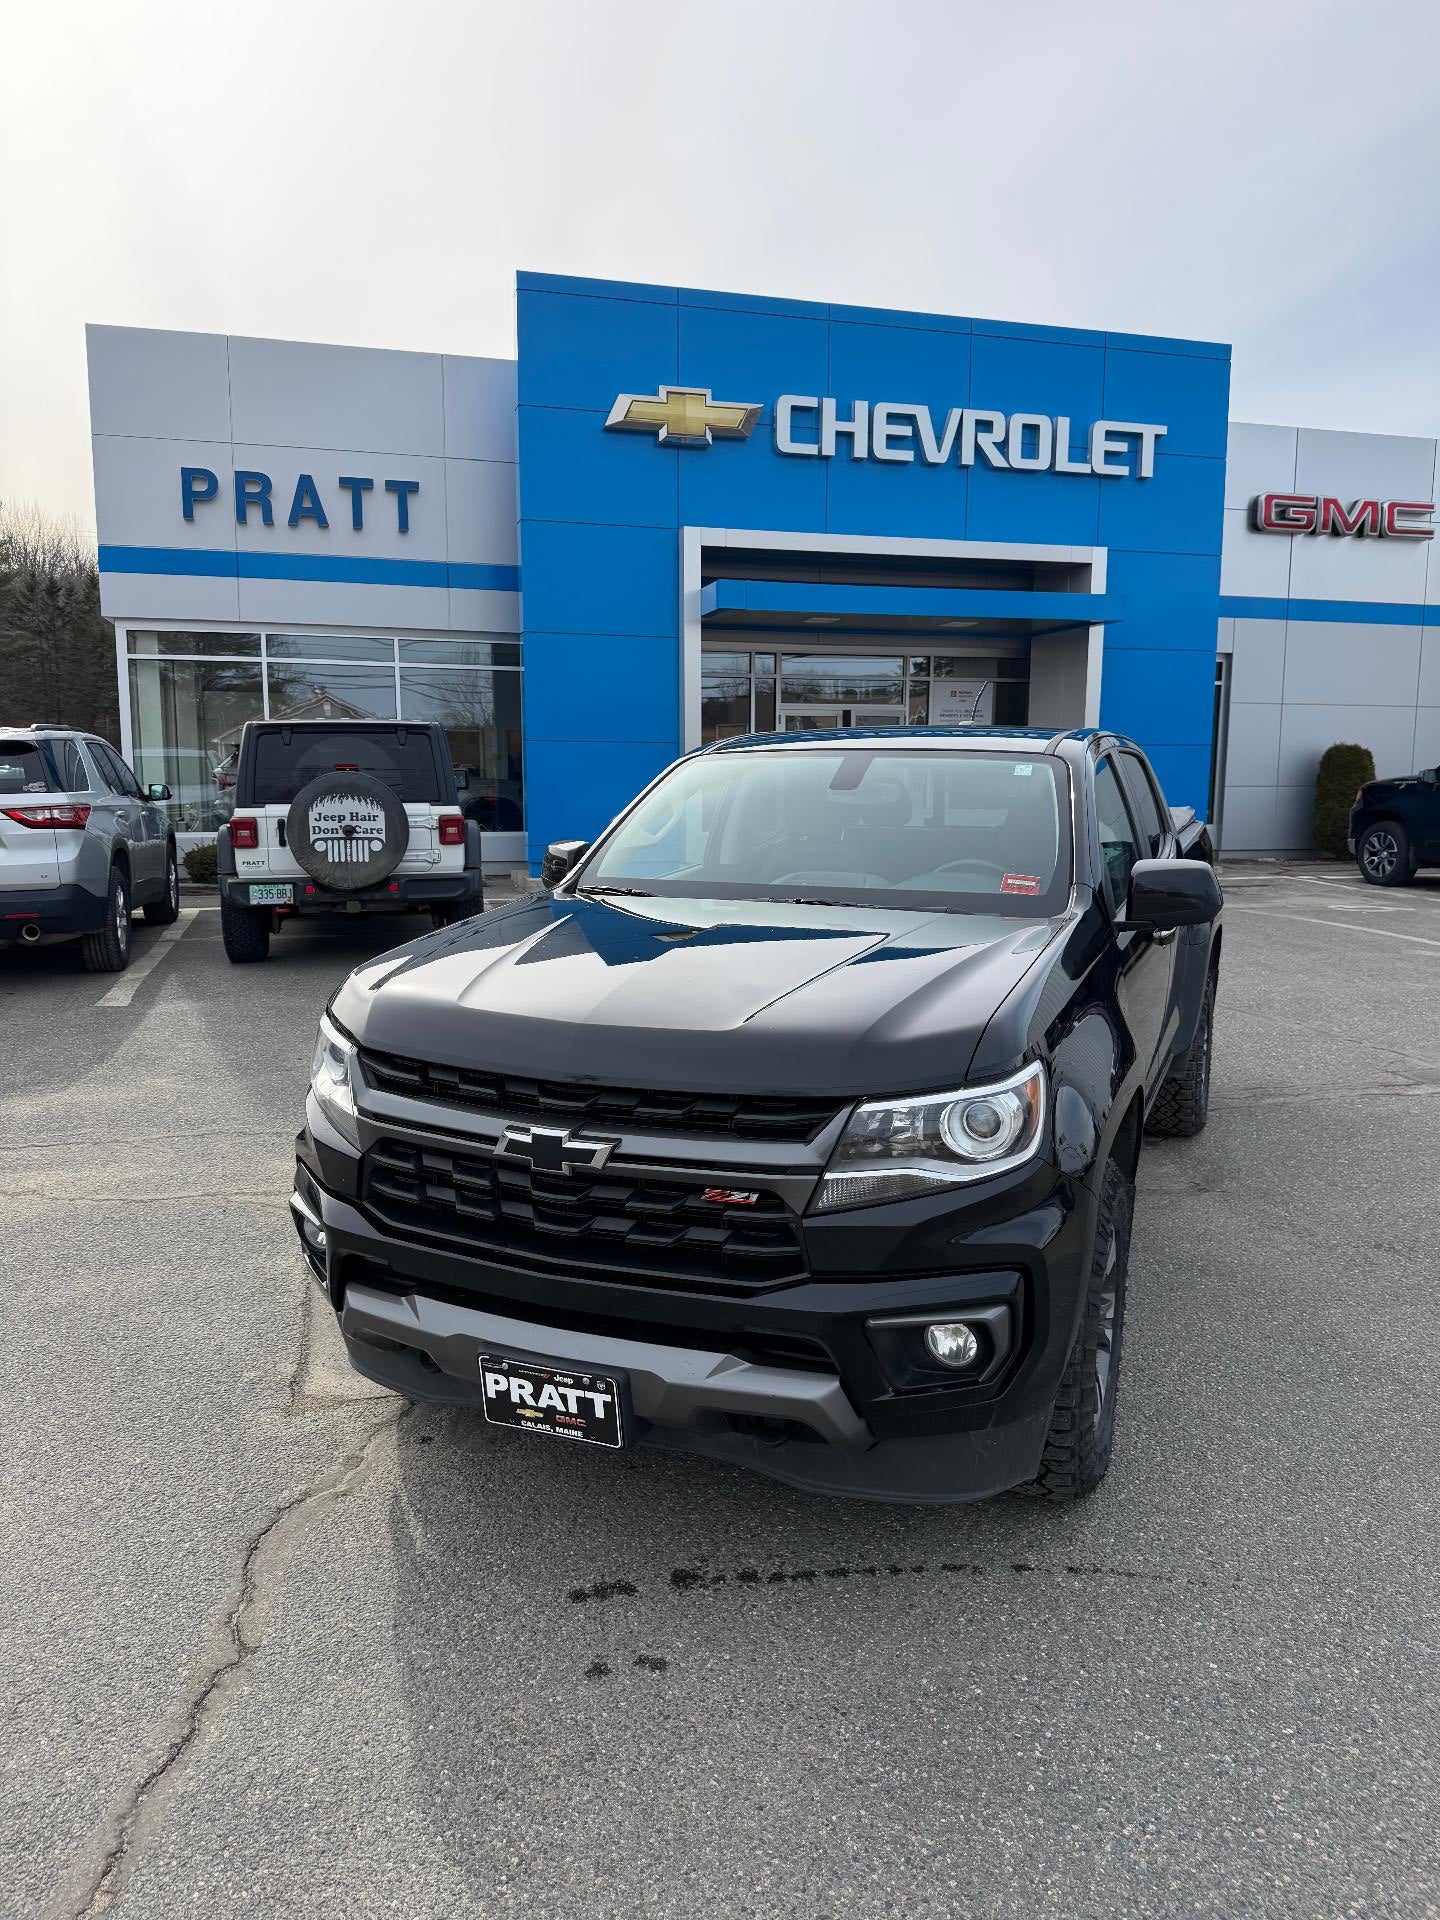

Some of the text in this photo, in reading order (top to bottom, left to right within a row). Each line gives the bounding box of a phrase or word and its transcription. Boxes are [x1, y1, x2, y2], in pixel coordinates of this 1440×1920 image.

[774, 394, 1168, 480] CHEVROLET
[180, 466, 420, 533] PRATT
[1250, 492, 1436, 540] GMC
[314, 812, 379, 823] Jeep Hair
[312, 825, 384, 835] Don' Care
[554, 1374, 574, 1385] Jeep
[485, 1372, 612, 1419] PRATT
[520, 1420, 584, 1438] CALAIS, MAINE
[555, 1414, 587, 1428] GMC
